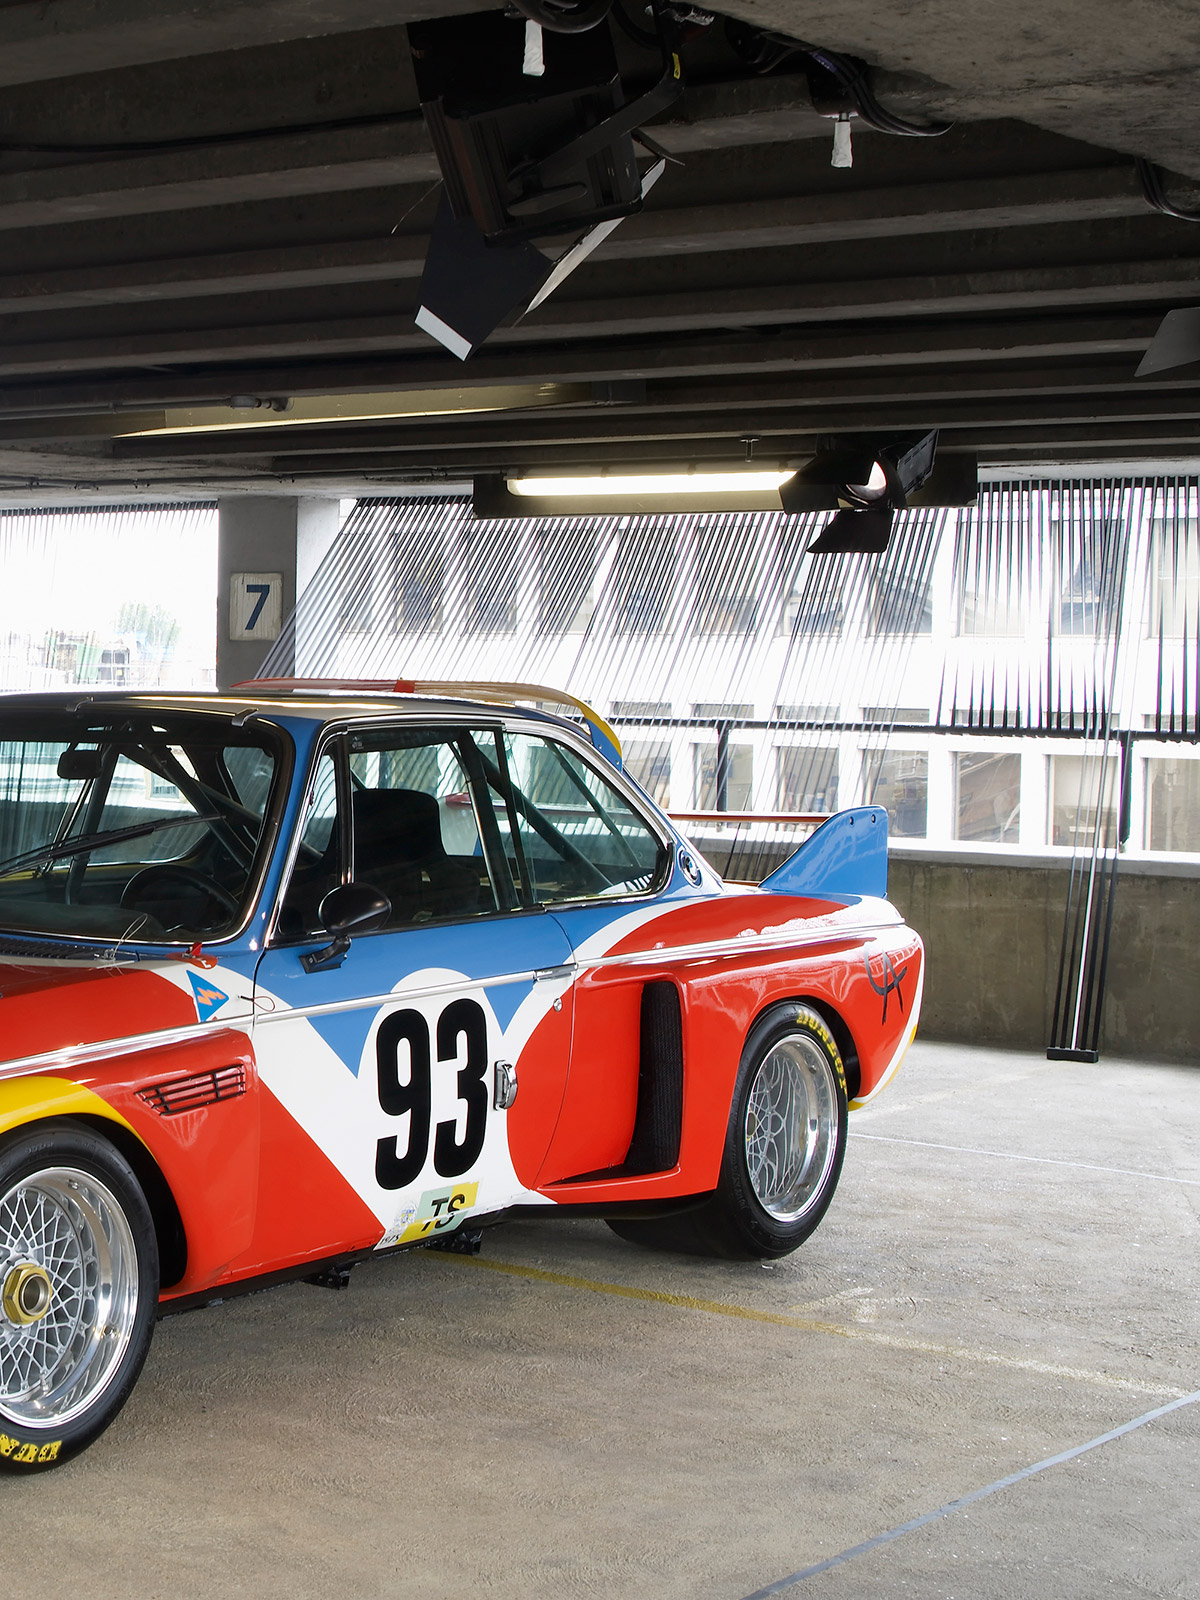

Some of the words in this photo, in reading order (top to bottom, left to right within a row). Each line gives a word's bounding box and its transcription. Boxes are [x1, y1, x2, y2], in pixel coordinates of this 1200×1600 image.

[245, 584, 270, 630] 7
[375, 998, 488, 1190] 93
[421, 1193, 466, 1232] TS
